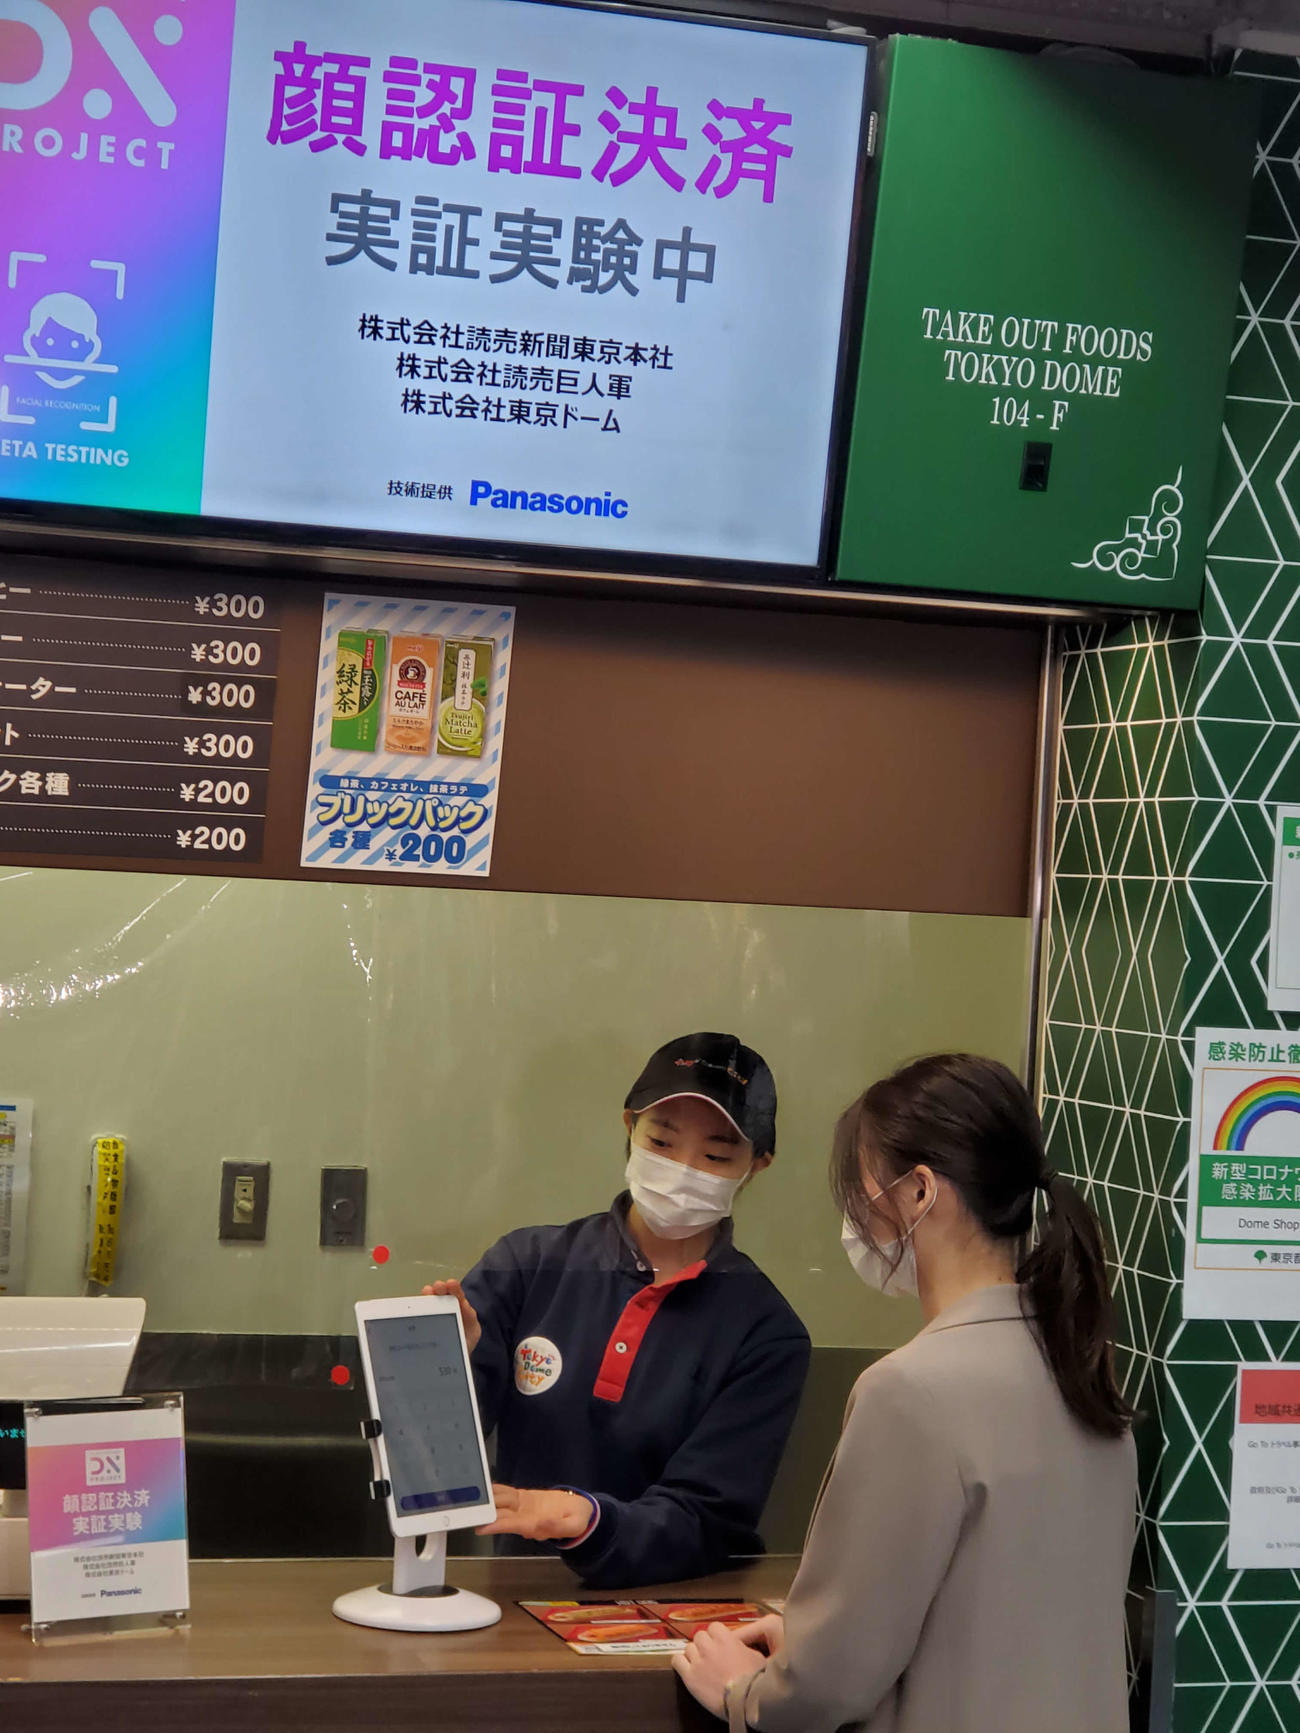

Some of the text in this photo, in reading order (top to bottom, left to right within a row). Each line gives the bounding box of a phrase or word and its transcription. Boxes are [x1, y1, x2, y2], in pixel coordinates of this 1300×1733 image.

[266, 40, 793, 203] 顔認証決済
[324, 188, 717, 303] 実証実験中
[358, 312, 674, 371] 株式会社読売新聞東京本社
[922, 307, 1153, 362] TAKE OUT FOODS
[396, 351, 633, 401] 株式会社読売巨人軍
[944, 350, 1122, 397] TOKYO DOME
[400, 387, 621, 433] 株式会社東京ドーム
[990, 396, 1030, 428] 104
[1049, 400, 1069, 430] F
[44, 443, 130, 467] TESTING
[387, 479, 629, 519] 技術提供 Panasonic
[194, 593, 265, 619] ¥300
[191, 640, 261, 666] ¥300
[0, 676, 256, 708] ーター ¥300
[336, 663, 359, 713] 緑茶
[408, 702, 426, 710] LAIT
[445, 718, 478, 728] Matcha
[449, 726, 472, 736] Latte
[183, 733, 254, 759] ¥300
[179, 780, 250, 805] ¥200
[316, 792, 488, 834] ブリックパック
[176, 826, 246, 851] ¥200
[385, 832, 467, 864] ¥200
[1239, 1218, 1300, 1232] Dome Shop
[72, 1511, 143, 1536] 実証実験
